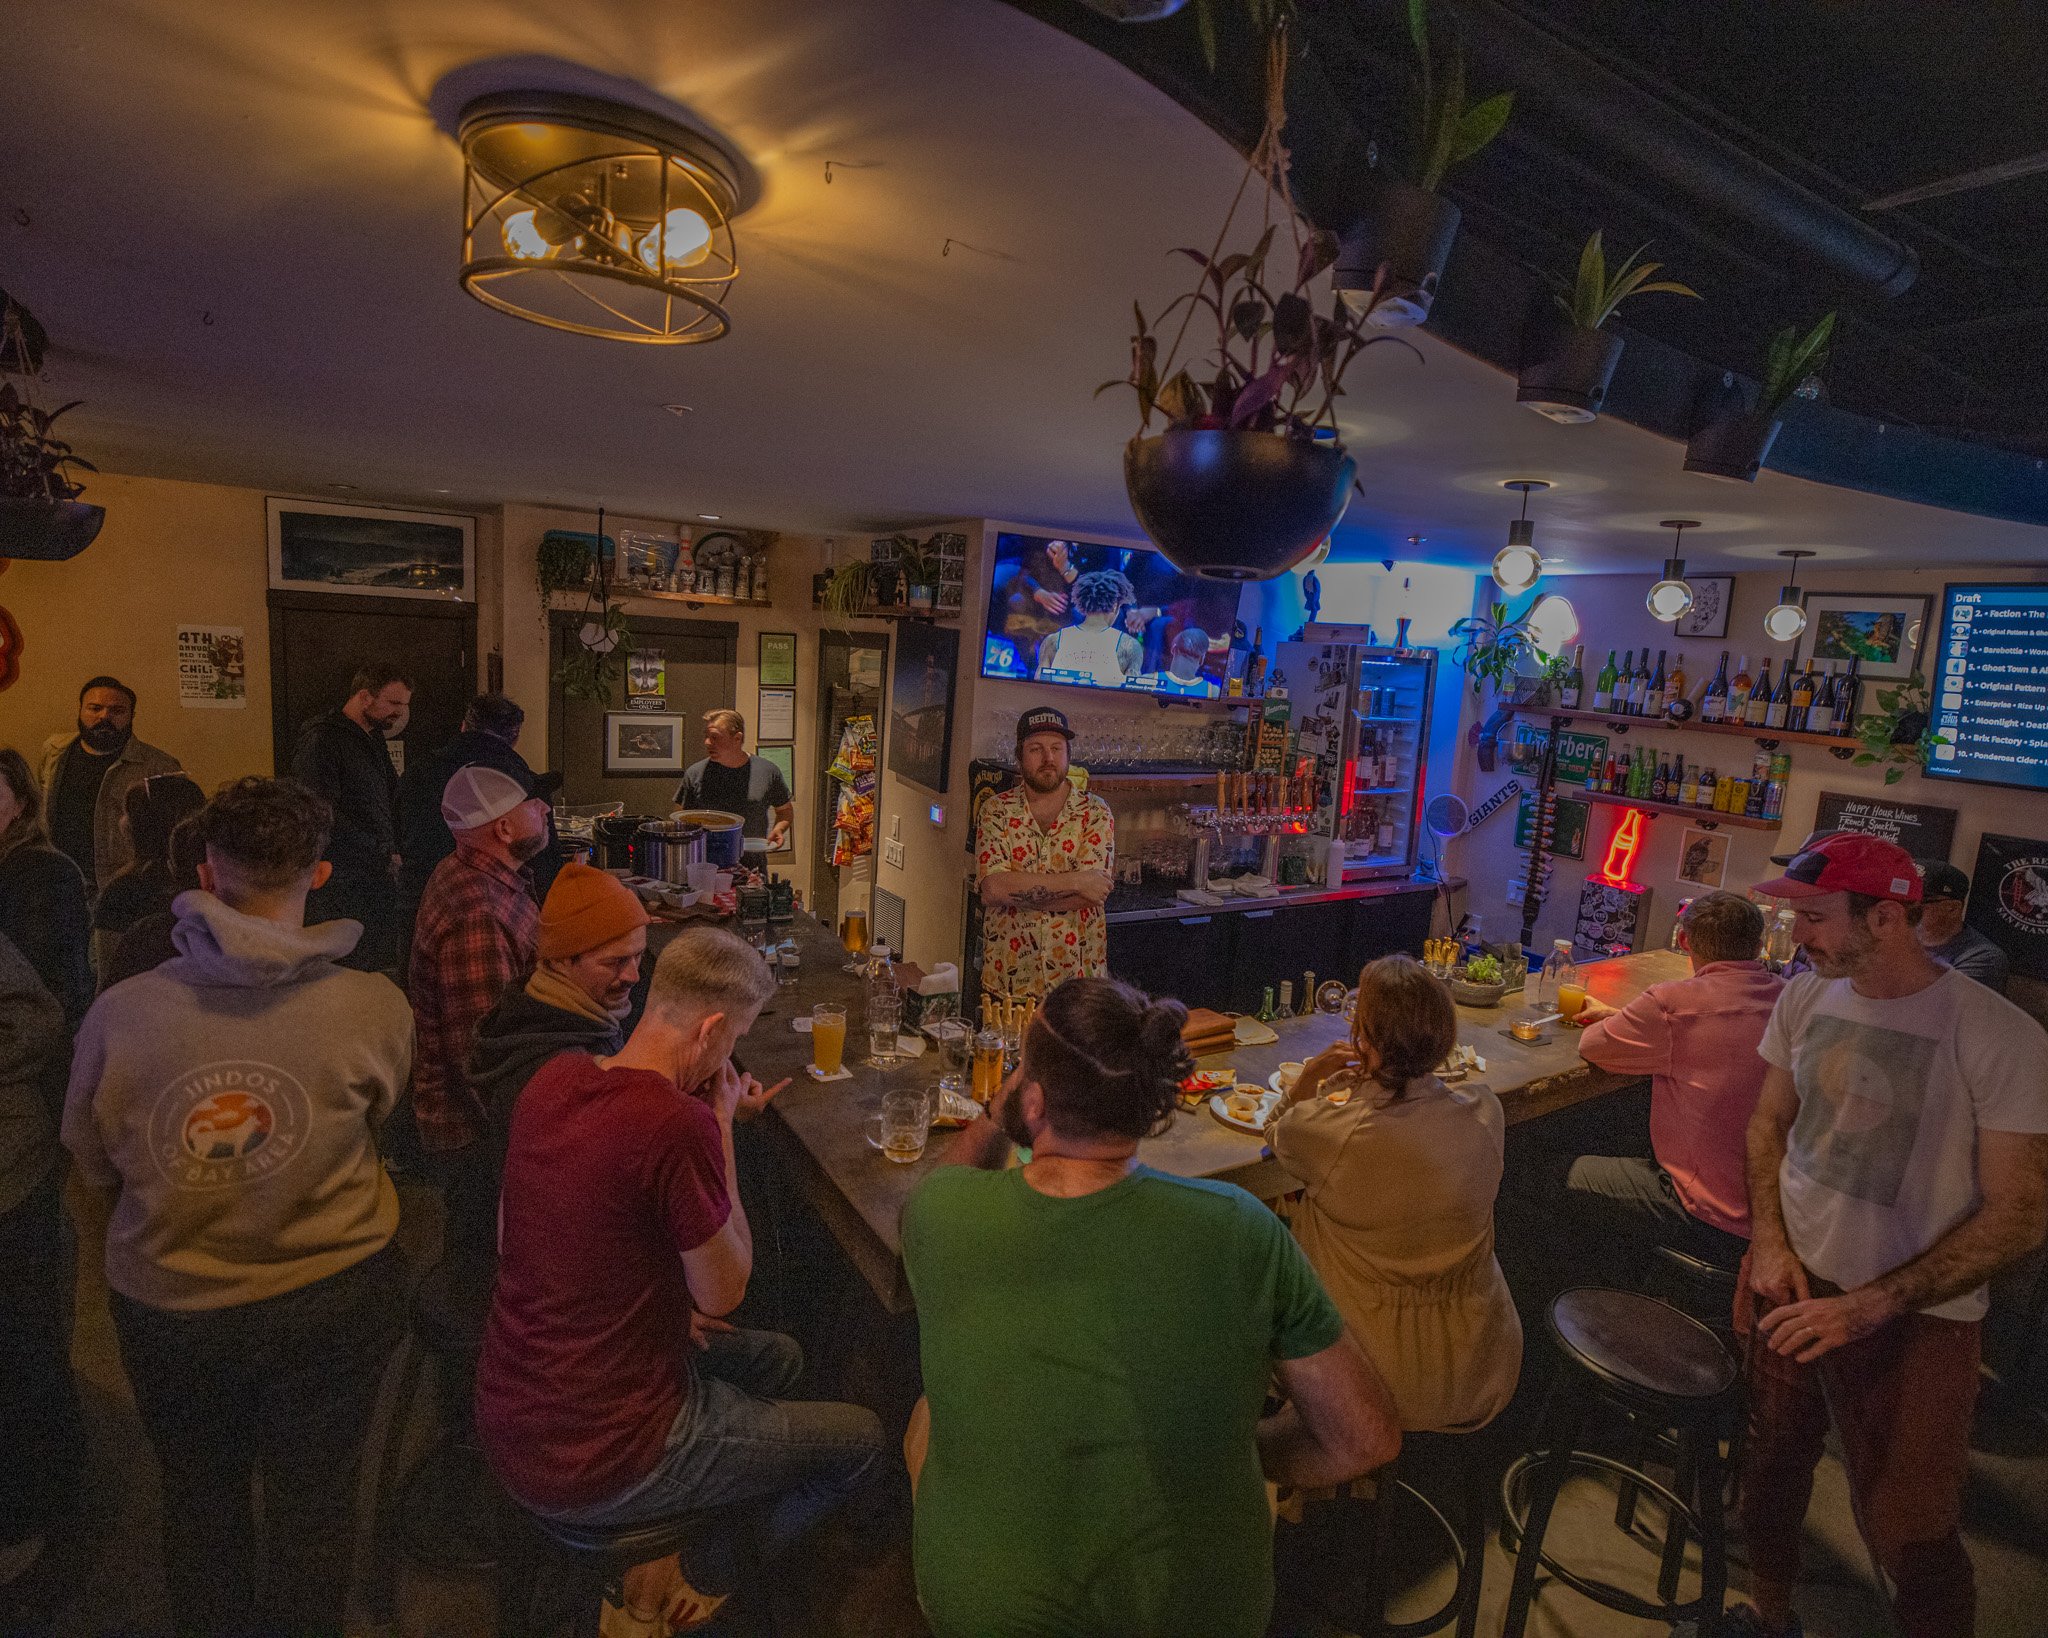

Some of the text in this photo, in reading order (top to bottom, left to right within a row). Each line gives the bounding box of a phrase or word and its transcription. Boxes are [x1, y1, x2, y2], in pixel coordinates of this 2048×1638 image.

[1955, 594, 1981, 603] Draft
[1989, 610, 2021, 618] Faction
[2028, 611, 2046, 619] The
[178, 631, 213, 645] 4TH
[767, 642, 788, 650] PASS
[1983, 647, 2024, 655] Barebottle
[1981, 665, 2006, 673] Ghost
[2007, 666, 2029, 674] Town
[1980, 682, 2013, 691] Original
[2014, 684, 2046, 693] Pattern
[630, 698, 663, 706] EMPLOYEES
[1974, 699, 2011, 708] Enterprise
[2017, 702, 2033, 710] Rize
[1028, 712, 1064, 727] REDTAIL
[1975, 717, 2019, 728] Moonlight
[1973, 734, 1991, 743] Brix
[1990, 735, 2023, 747] Factory
[1973, 752, 2015, 763] Ponderosa
[2015, 756, 2039, 765] Cider
[1468, 779, 1519, 827] GIANTS
[1868, 818, 1901, 834] Sparkling
[2003, 858, 2030, 870] THE
[2014, 921, 2048, 936] FRAN
[184, 1070, 281, 1099] JINDOS
